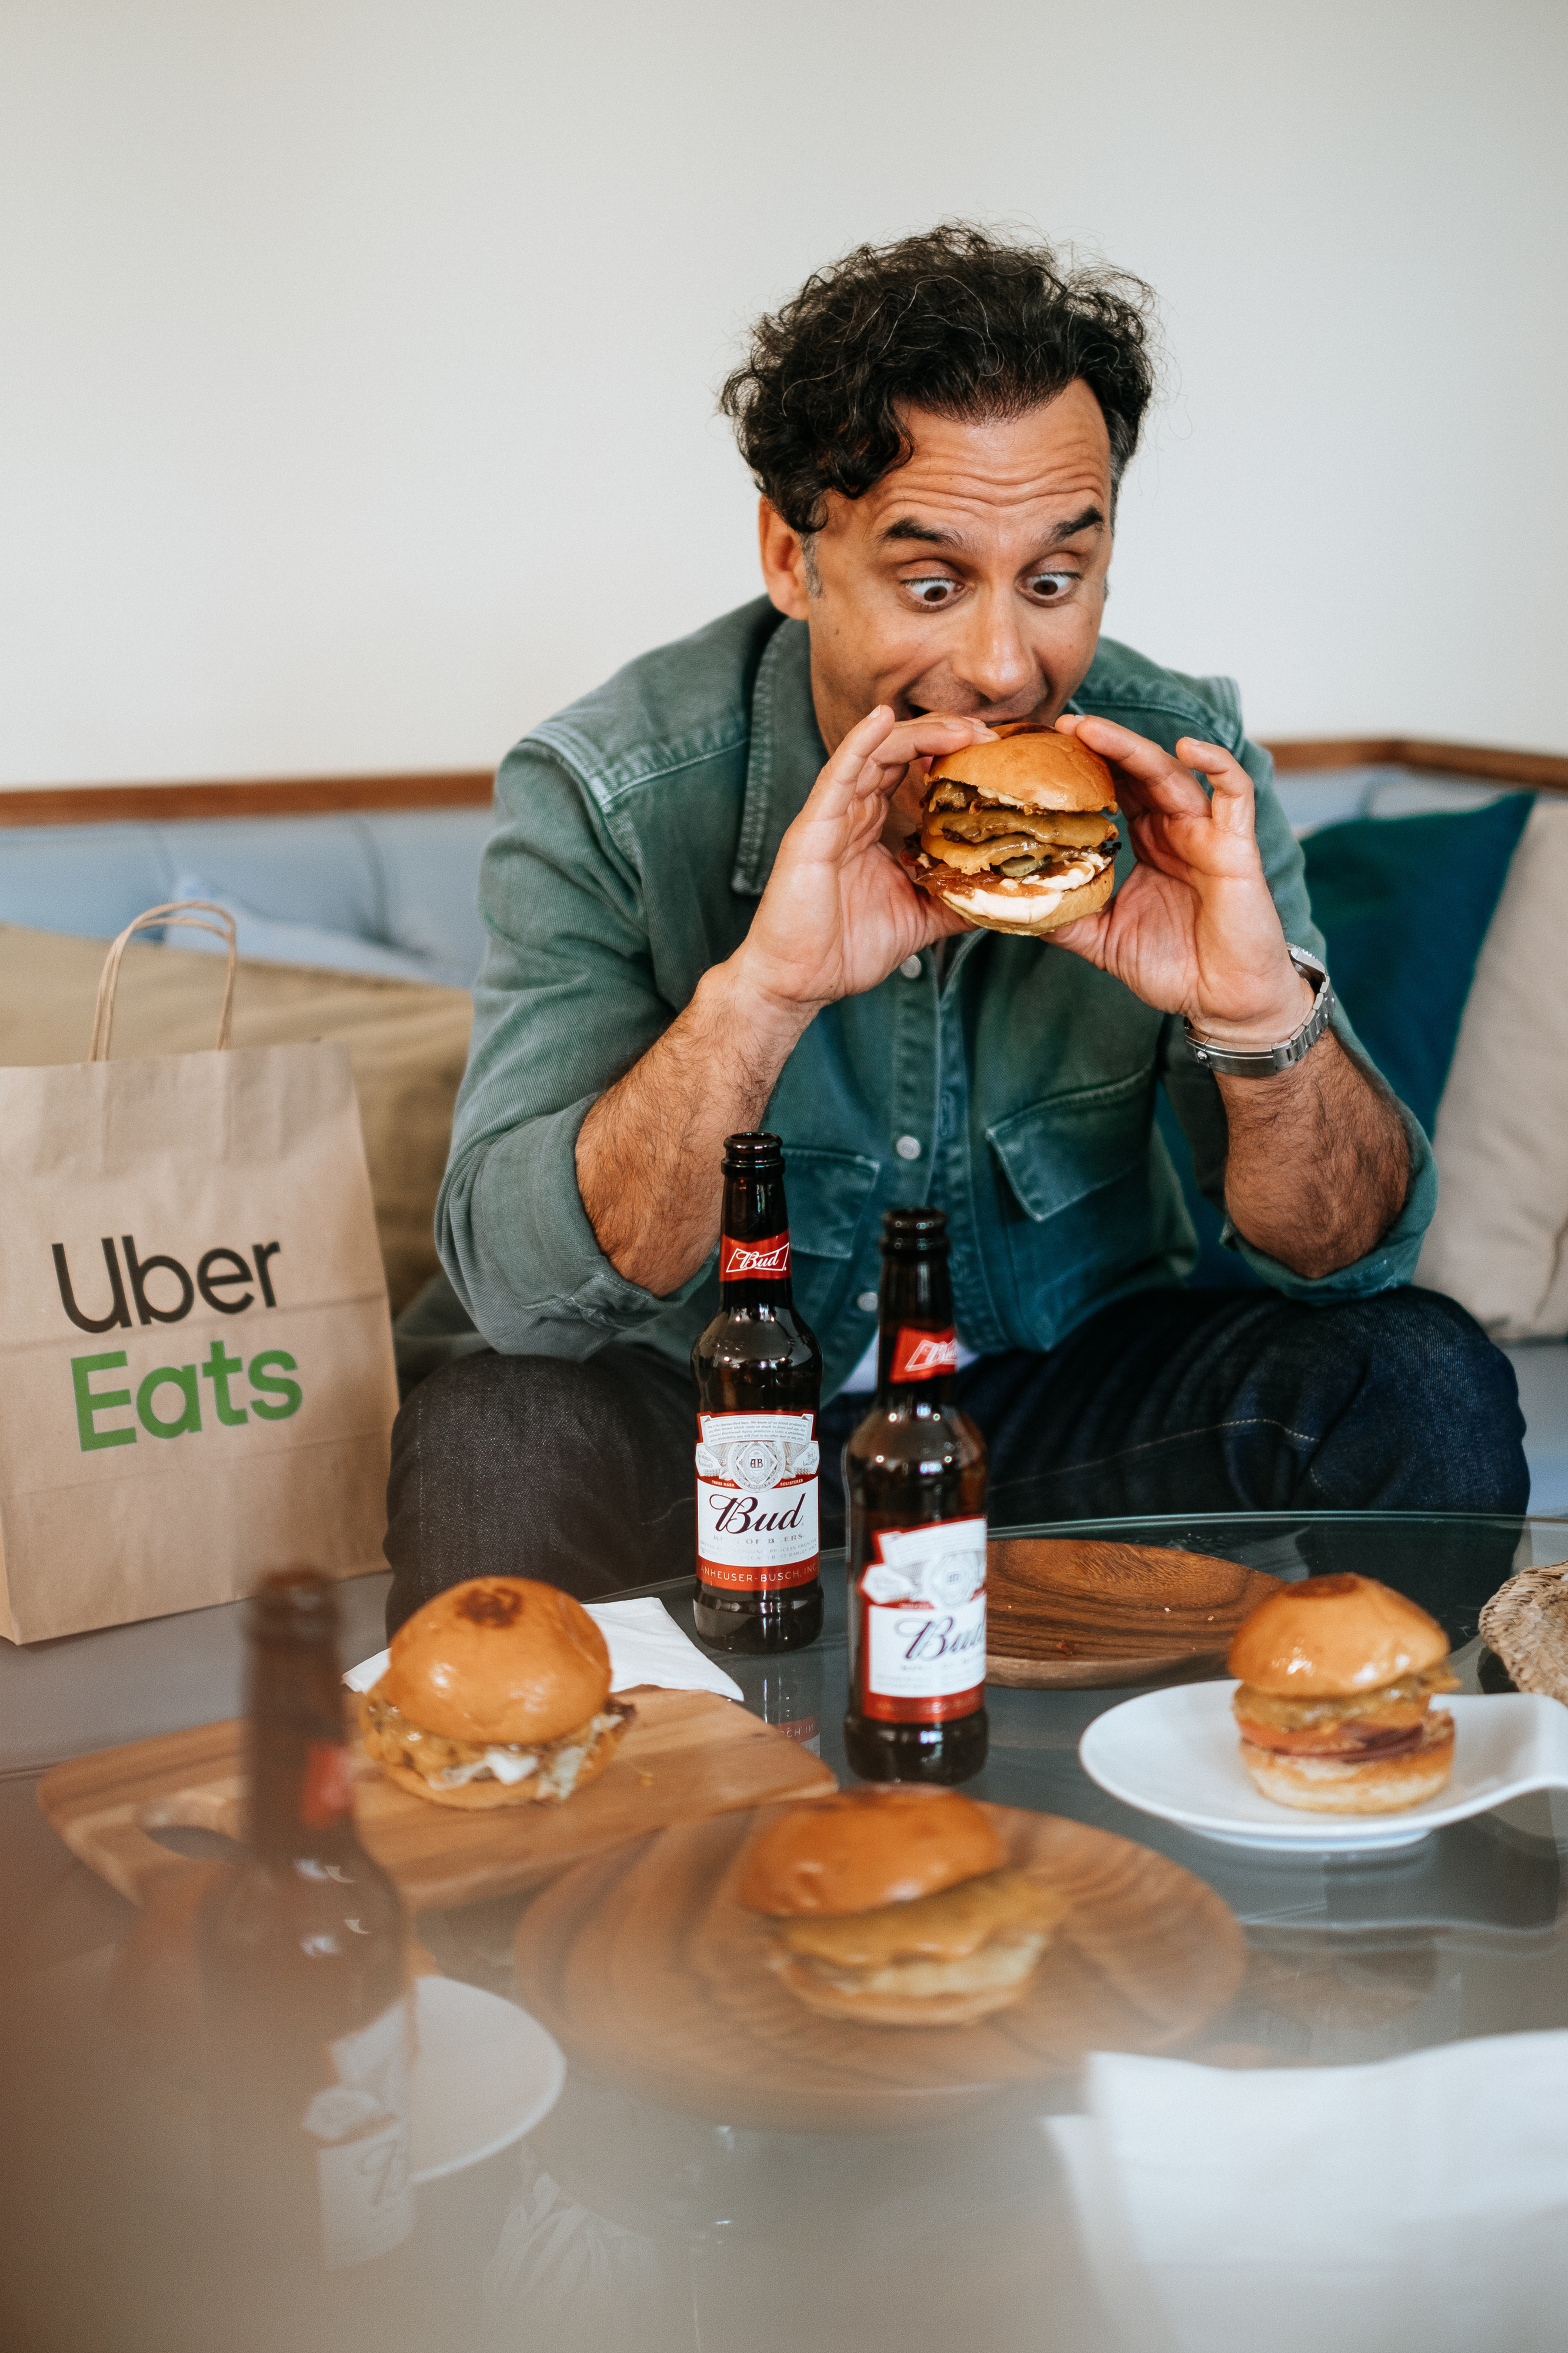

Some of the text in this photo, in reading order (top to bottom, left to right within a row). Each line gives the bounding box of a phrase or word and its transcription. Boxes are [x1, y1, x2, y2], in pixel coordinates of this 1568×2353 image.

[736, 1251, 779, 1269] Bud
[51, 1234, 281, 1334] Uber
[70, 1340, 303, 1452] Eats
[750, 1458, 764, 1468] AB
[780, 1478, 803, 1487] REGISTERED
[709, 1492, 806, 1534] Bud
